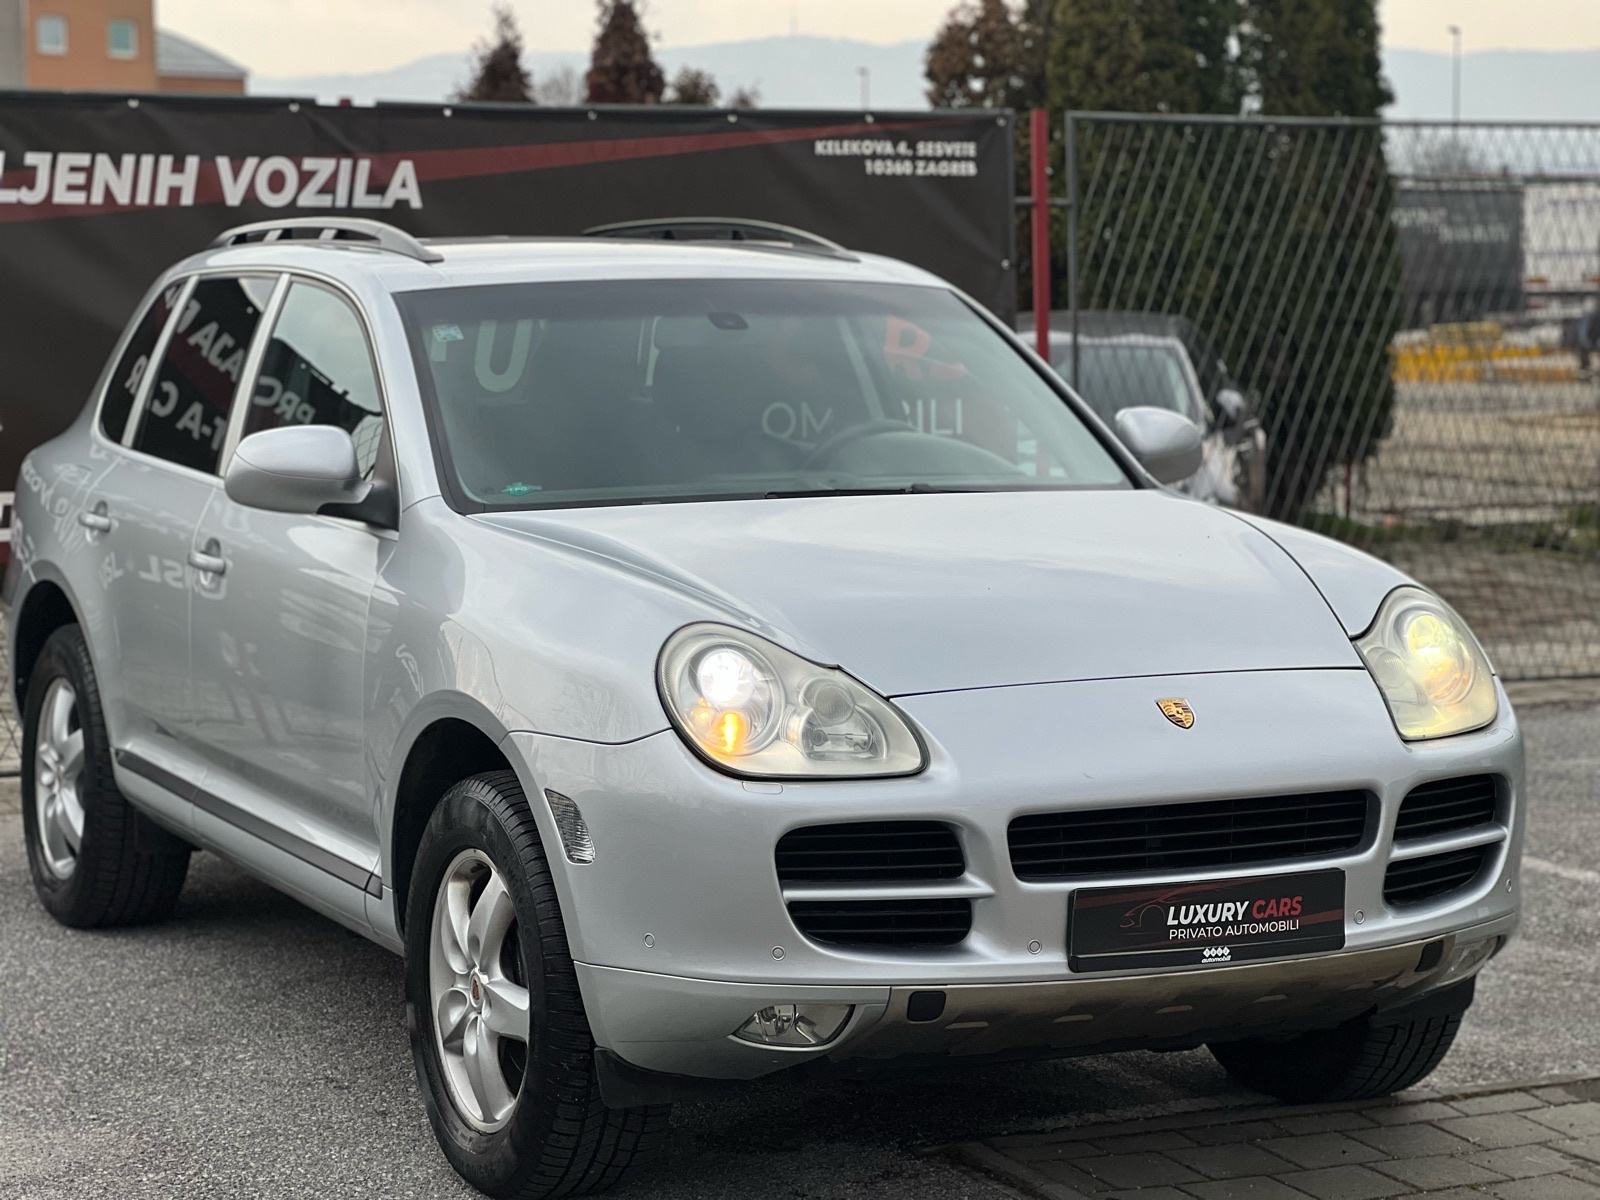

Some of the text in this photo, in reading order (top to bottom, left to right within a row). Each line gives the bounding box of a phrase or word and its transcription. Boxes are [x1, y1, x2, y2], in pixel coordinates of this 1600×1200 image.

[915, 160, 977, 177] ZAGREB
[215, 155, 423, 209] VOZILA
[1167, 896, 1302, 925] LUXURY CARS
[1169, 919, 1299, 940] PRIVATO AUTOMOBILI
